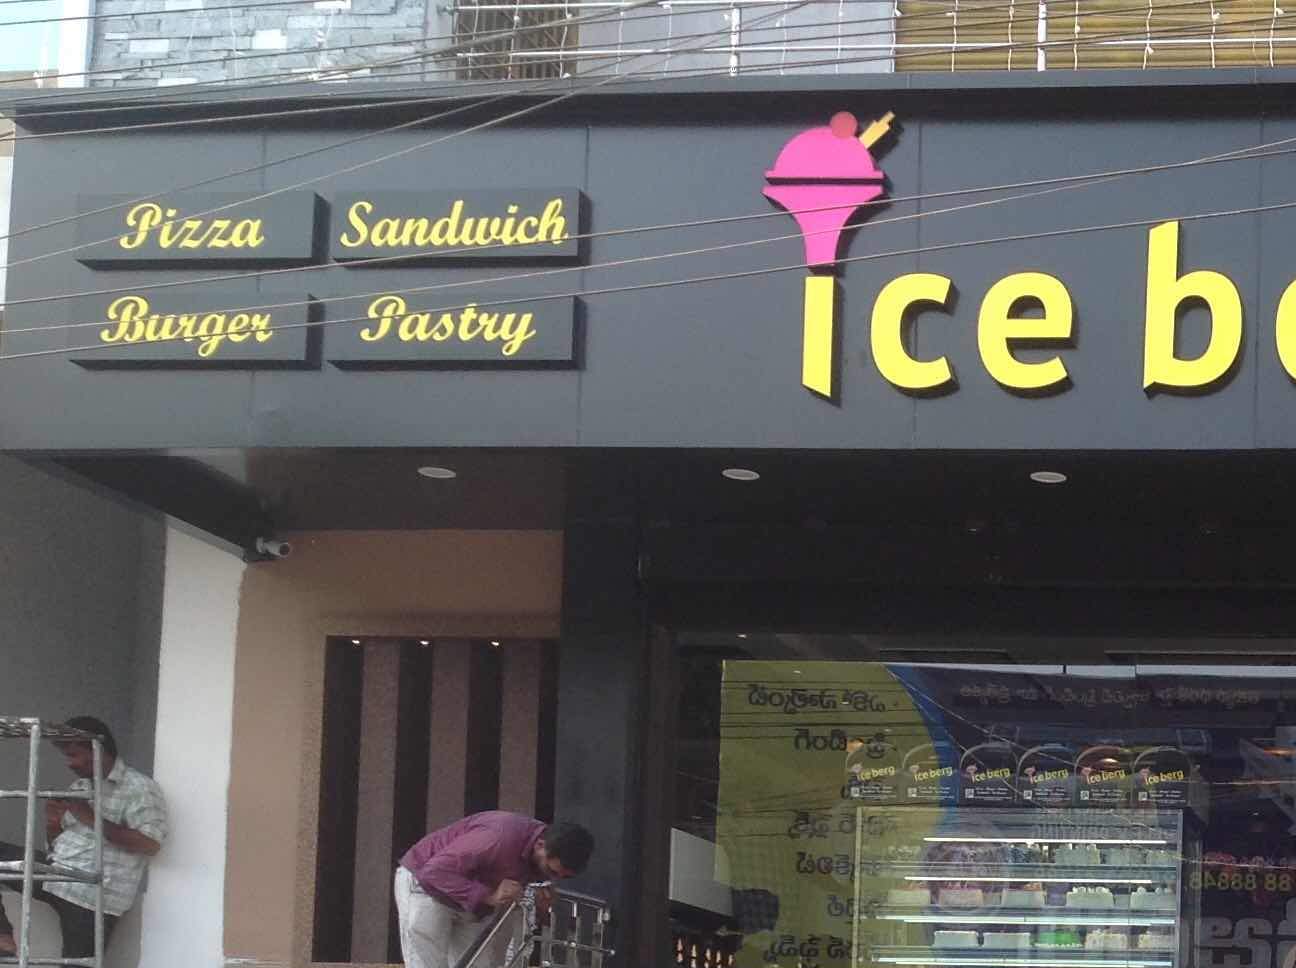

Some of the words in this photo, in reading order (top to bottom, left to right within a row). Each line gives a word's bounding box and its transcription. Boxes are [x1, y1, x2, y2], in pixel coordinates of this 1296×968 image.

[119, 203, 264, 249] Pizza
[340, 199, 568, 247] Sandwich
[100, 296, 272, 356] Burger
[360, 296, 535, 355] Pastry
[801, 271, 1074, 398] ice
